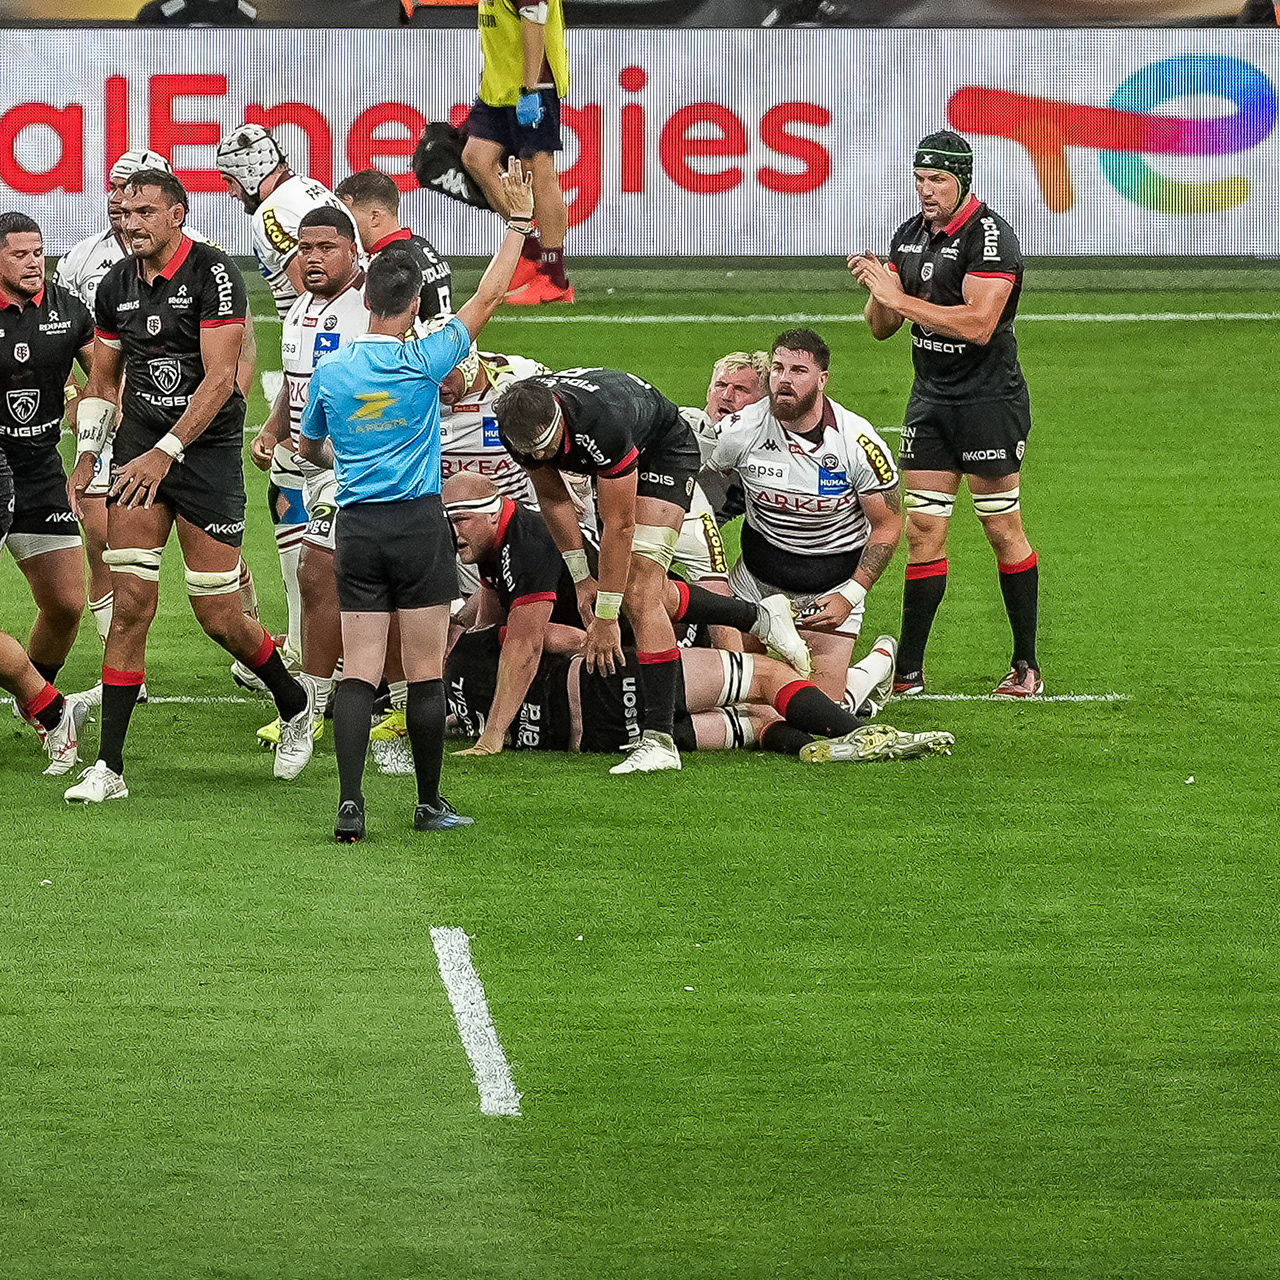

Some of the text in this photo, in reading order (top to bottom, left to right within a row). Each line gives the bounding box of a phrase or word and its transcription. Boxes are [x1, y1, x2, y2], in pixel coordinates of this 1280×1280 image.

[981, 217, 1001, 262] actual
[211, 263, 234, 316] actual
[441, 459, 512, 476] RKEA
[748, 465, 783, 479] epsa
[757, 490, 851, 513] ARKEA
